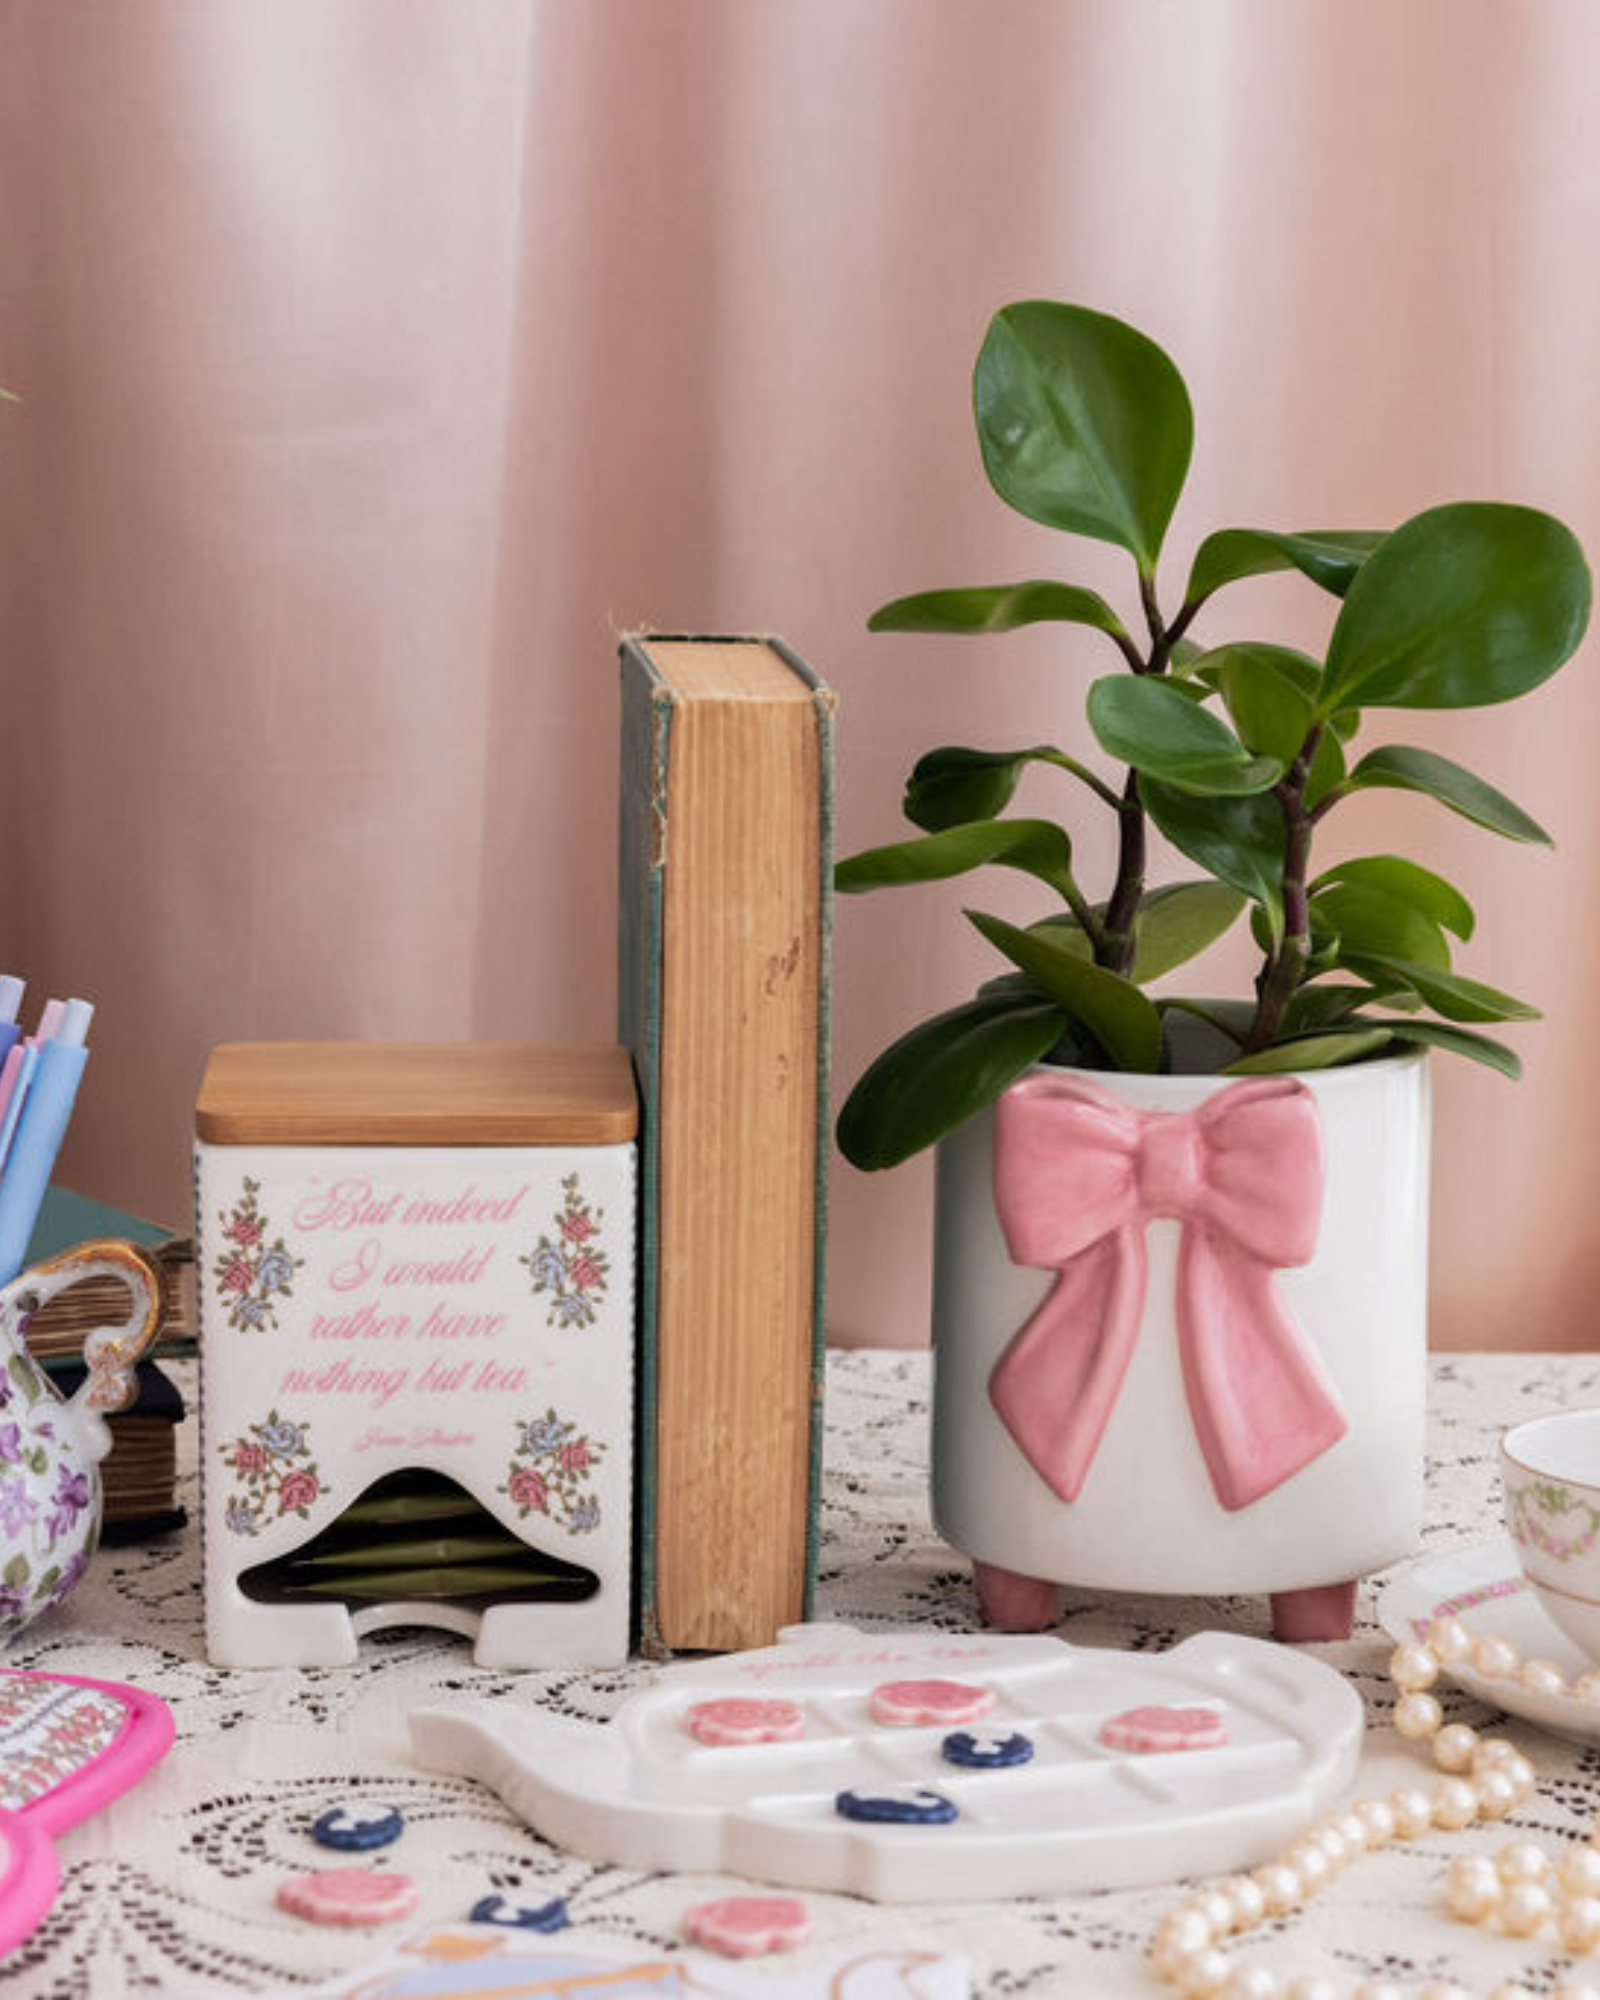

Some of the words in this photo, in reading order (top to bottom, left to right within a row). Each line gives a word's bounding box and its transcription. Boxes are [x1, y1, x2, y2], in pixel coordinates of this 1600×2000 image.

[402, 1184, 530, 1225] indeed
[329, 1238, 381, 1292] I
[382, 1244, 496, 1286] would
[311, 1301, 411, 1340] rather
[415, 1301, 507, 1338] have
[280, 1357, 408, 1409] nothing
[415, 1358, 474, 1393] but
